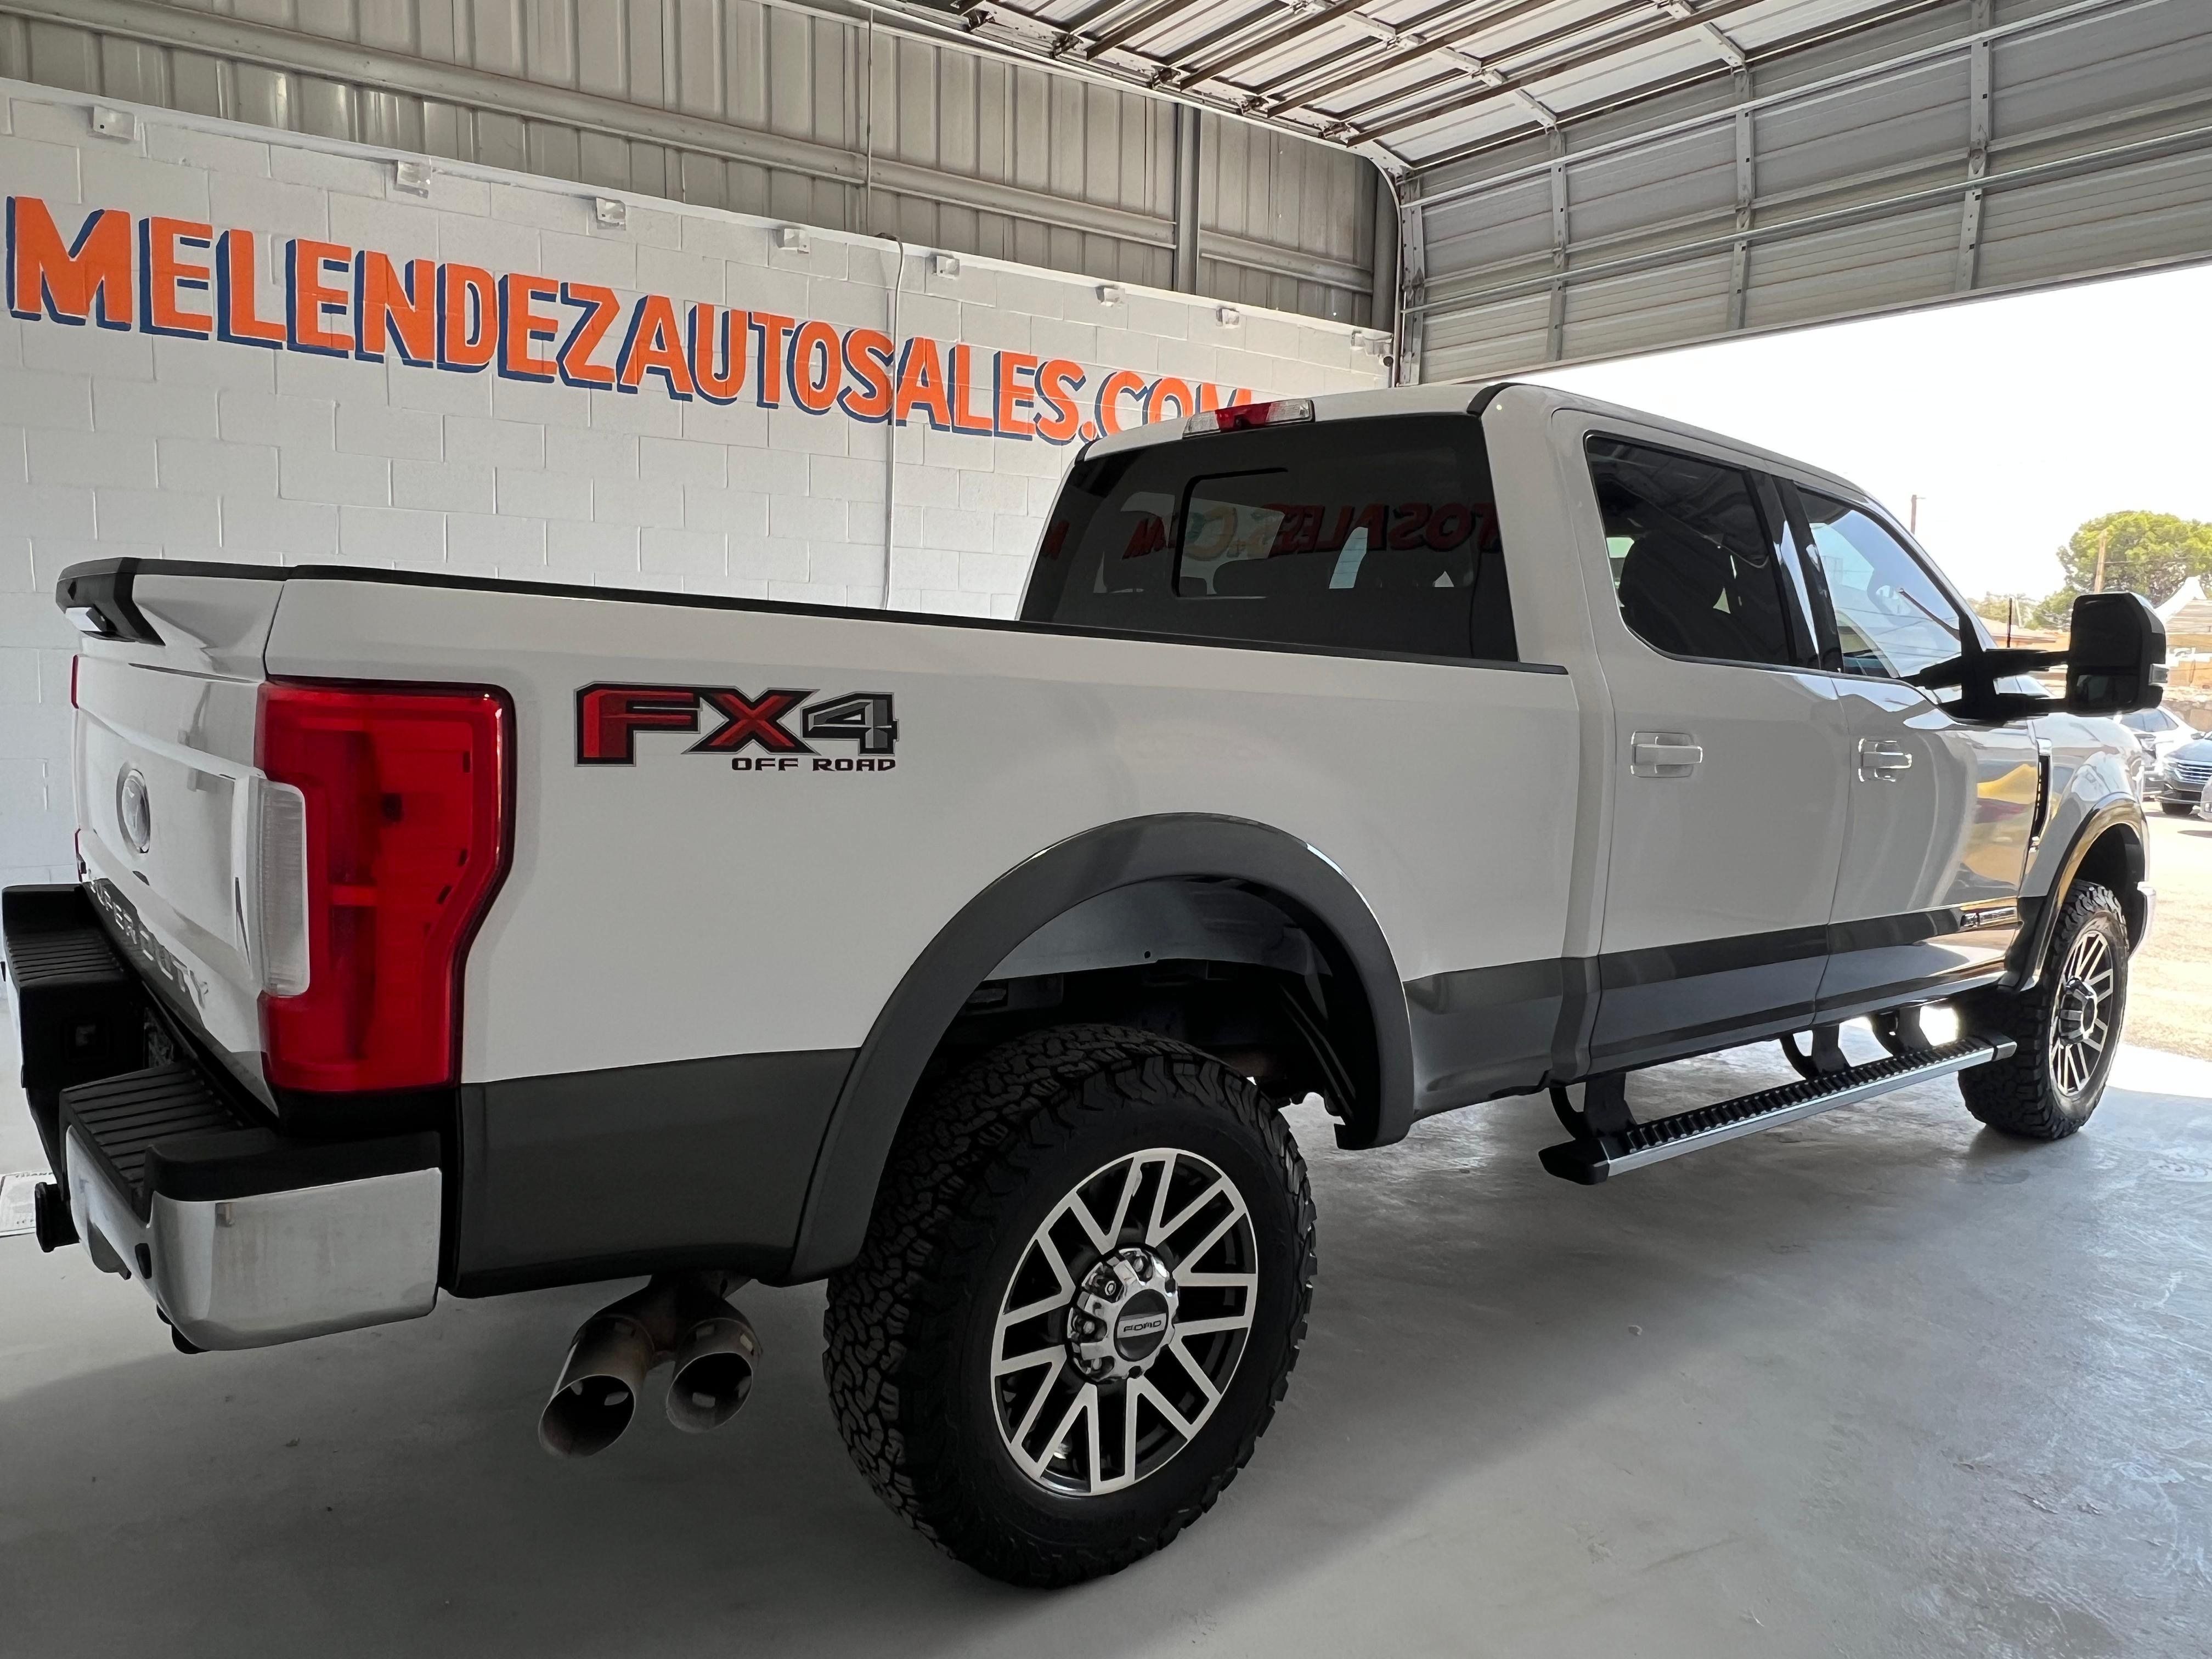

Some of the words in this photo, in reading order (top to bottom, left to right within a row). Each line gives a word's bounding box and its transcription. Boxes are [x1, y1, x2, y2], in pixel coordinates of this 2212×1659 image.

[574, 681, 899, 767] FX4
[732, 758, 798, 771] OFF
[812, 758, 896, 771] ROAD
[139, 922, 208, 1009] DUTY
